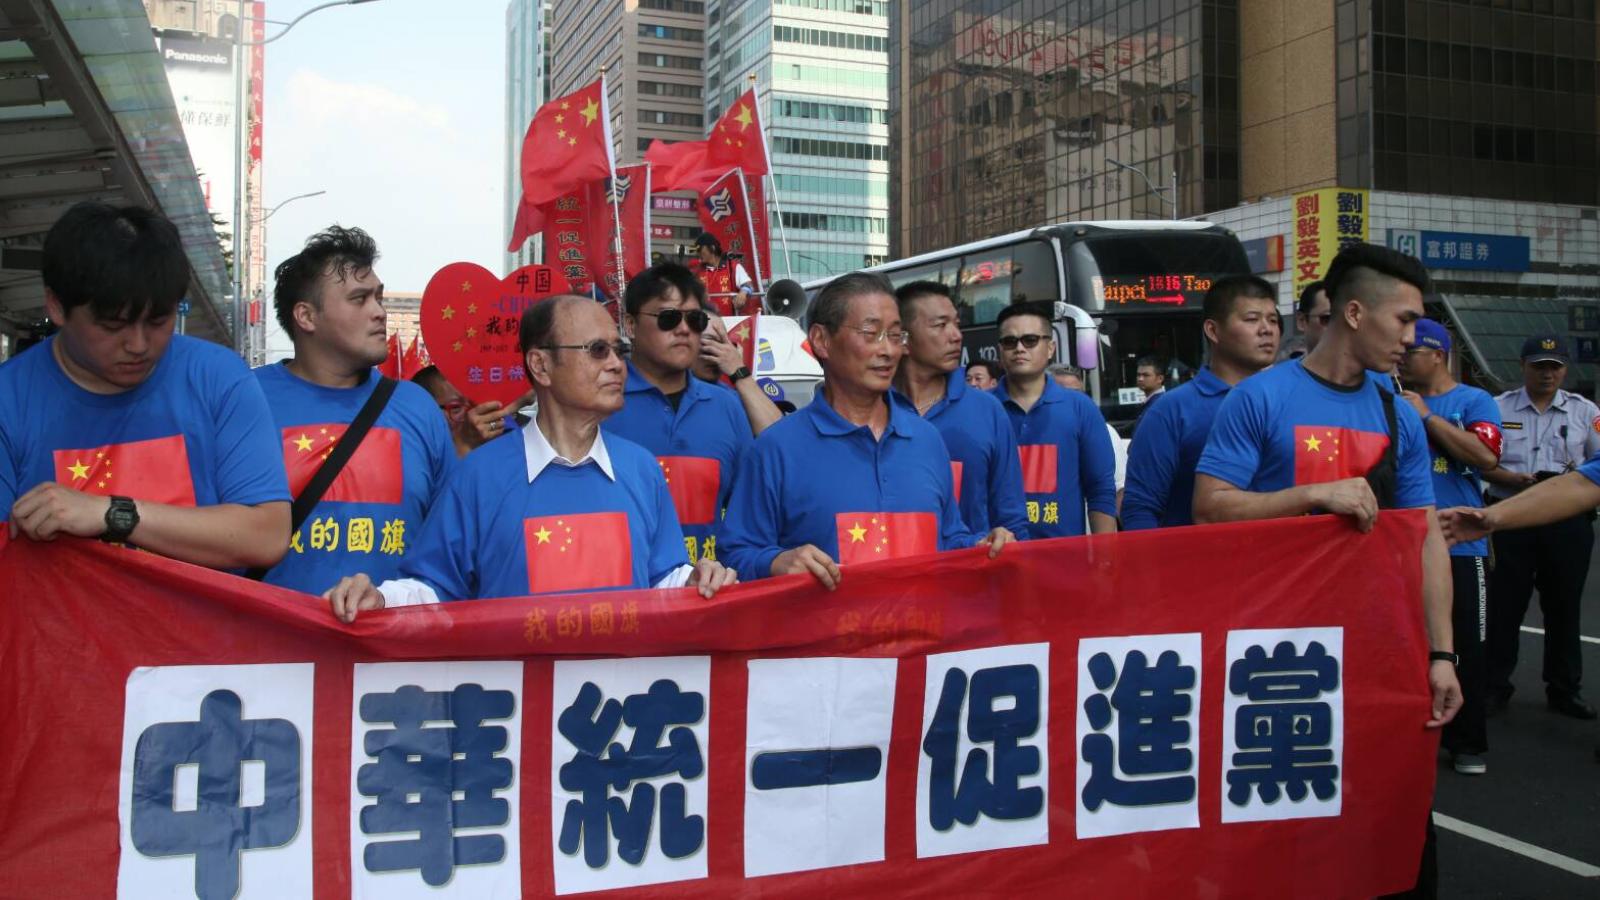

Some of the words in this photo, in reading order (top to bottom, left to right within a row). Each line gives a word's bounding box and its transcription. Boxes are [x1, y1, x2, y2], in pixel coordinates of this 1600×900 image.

[165, 48, 227, 64] Panasonic
[1296, 193, 1320, 281] 劉毅英文
[1426, 240, 1489, 261] 富邦證券
[516, 269, 551, 293] 中国
[486, 316, 519, 336] 我的
[131, 640, 1343, 900] 中華統一促進黨
